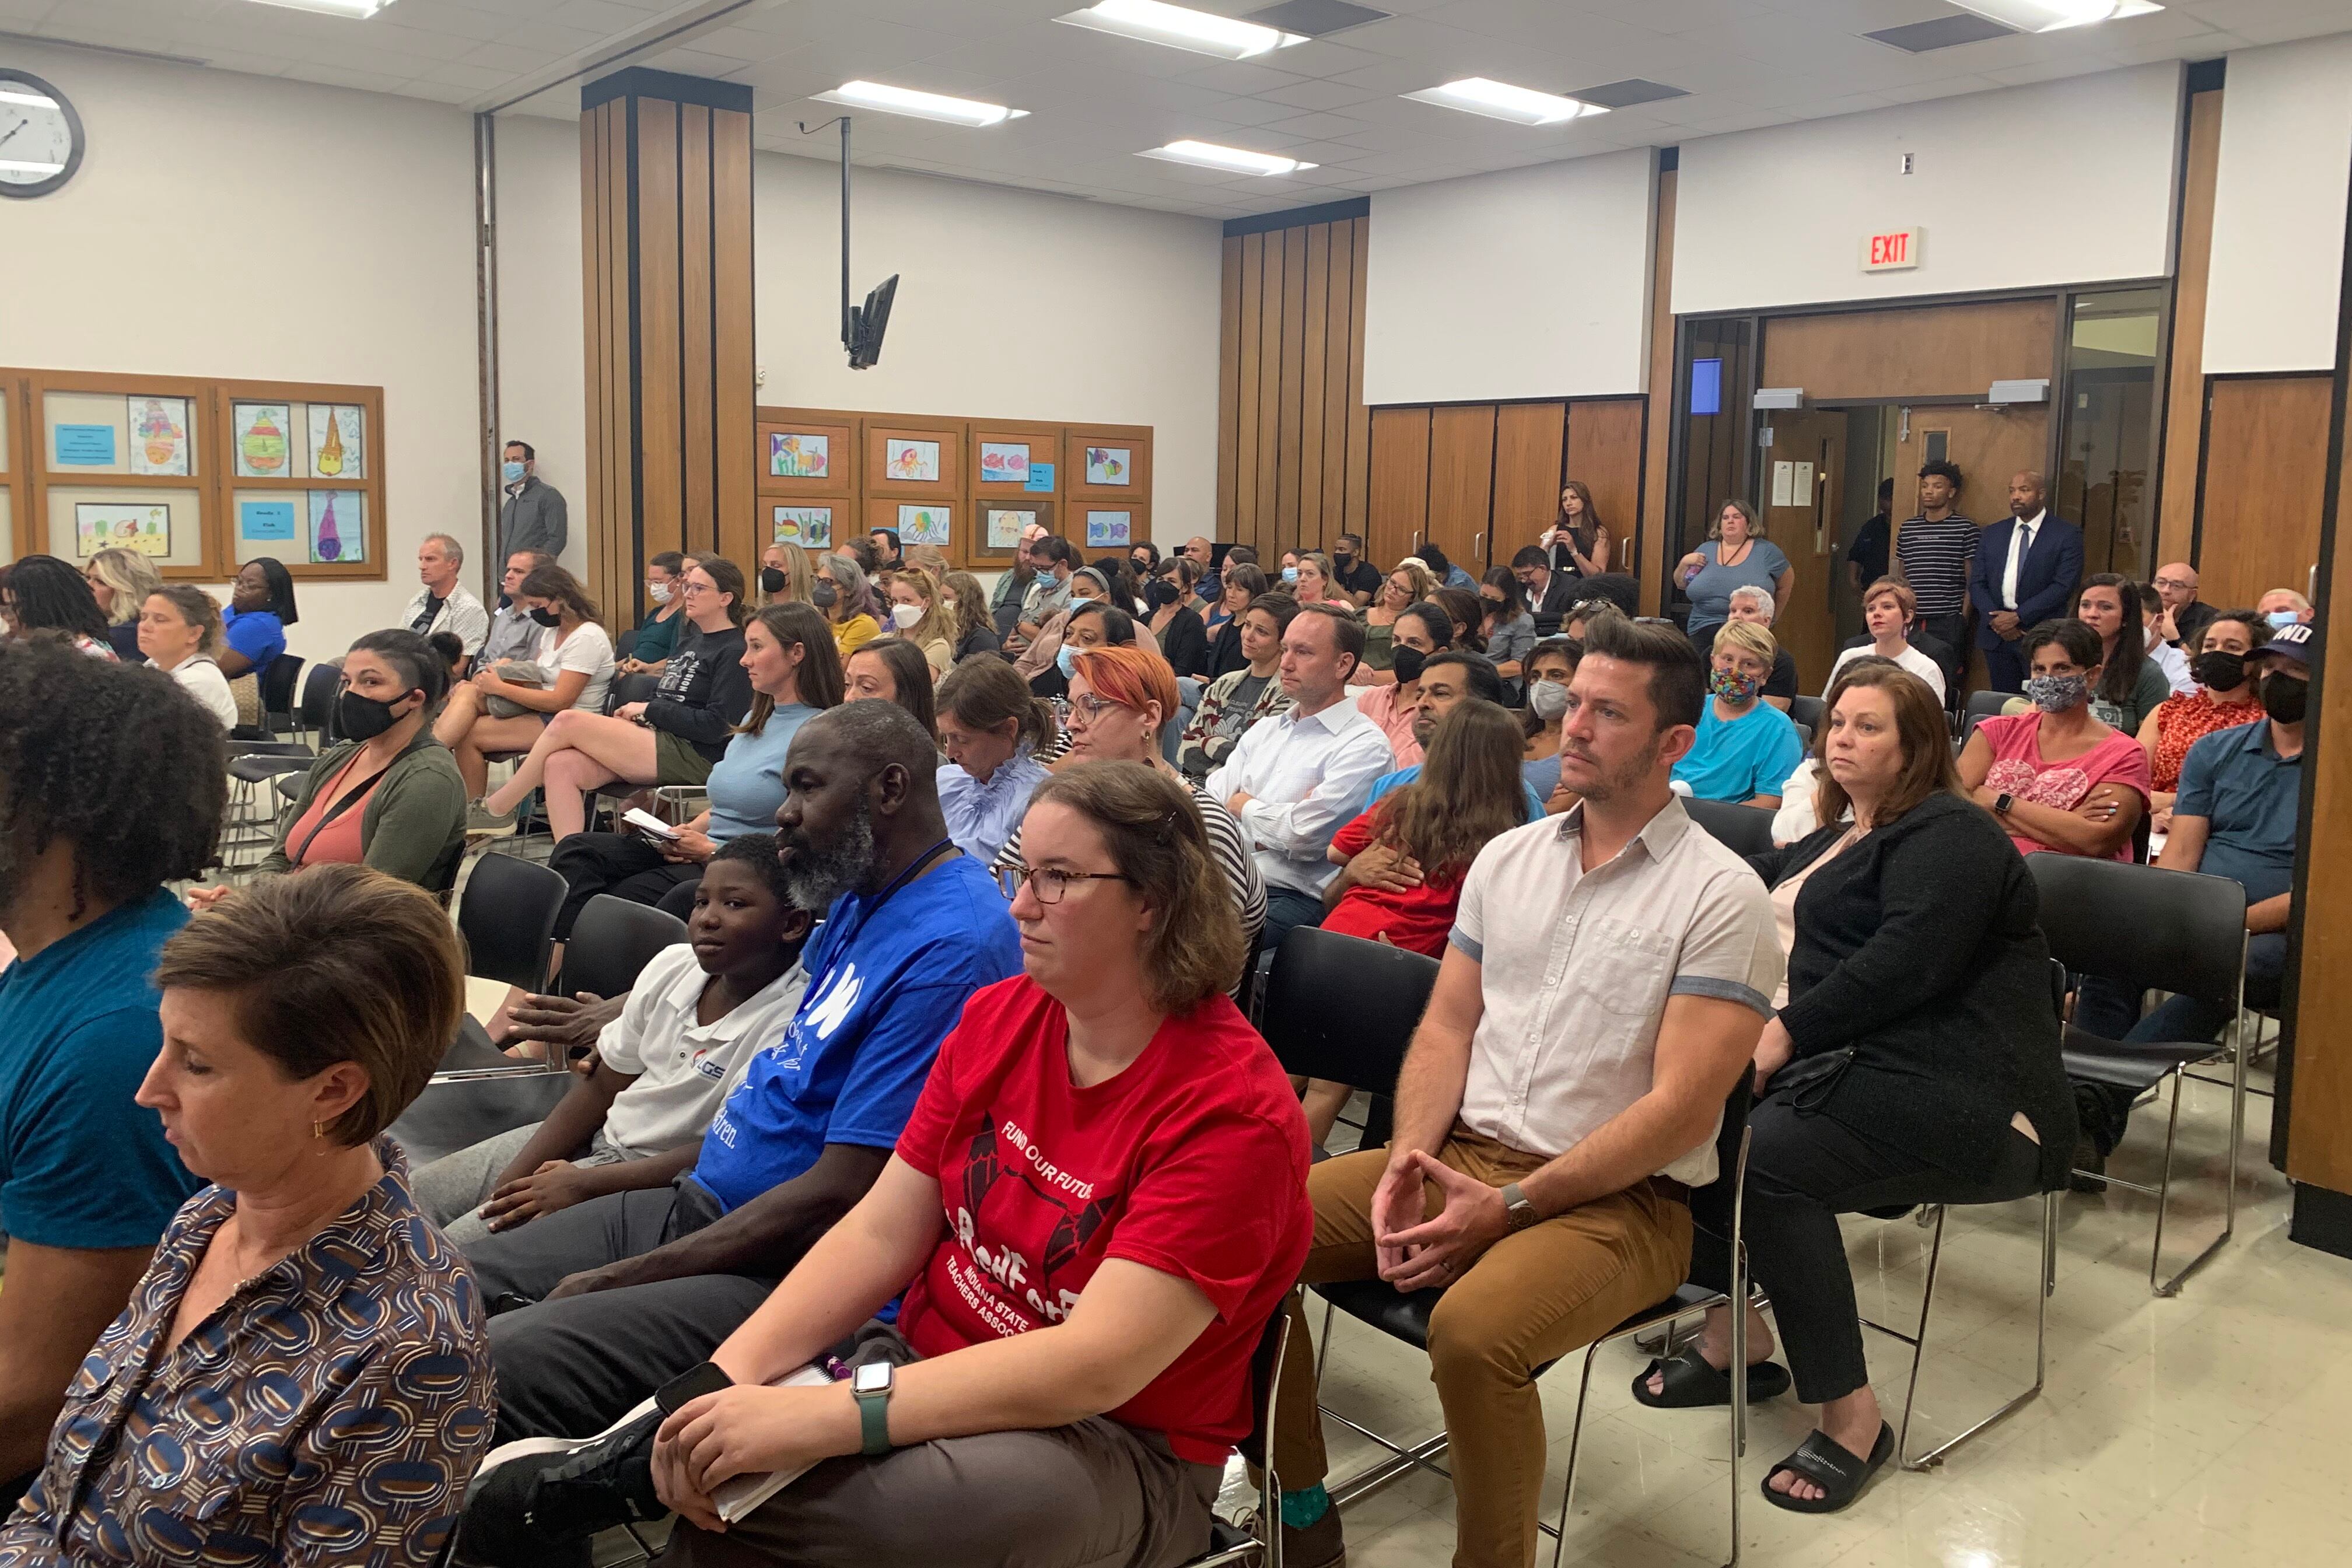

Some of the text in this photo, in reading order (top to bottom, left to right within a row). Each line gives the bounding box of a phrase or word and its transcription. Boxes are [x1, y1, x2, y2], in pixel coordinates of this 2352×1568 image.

[1871, 233, 1909, 264] EXIT
[712, 1110, 737, 1149] dren.
[1001, 1120, 1028, 1151] FUND
[1025, 1145, 1058, 1182] OUR
[946, 1255, 1019, 1338] TEACHERS ASSOC
[964, 1265, 1030, 1332] INDIANA STATE
